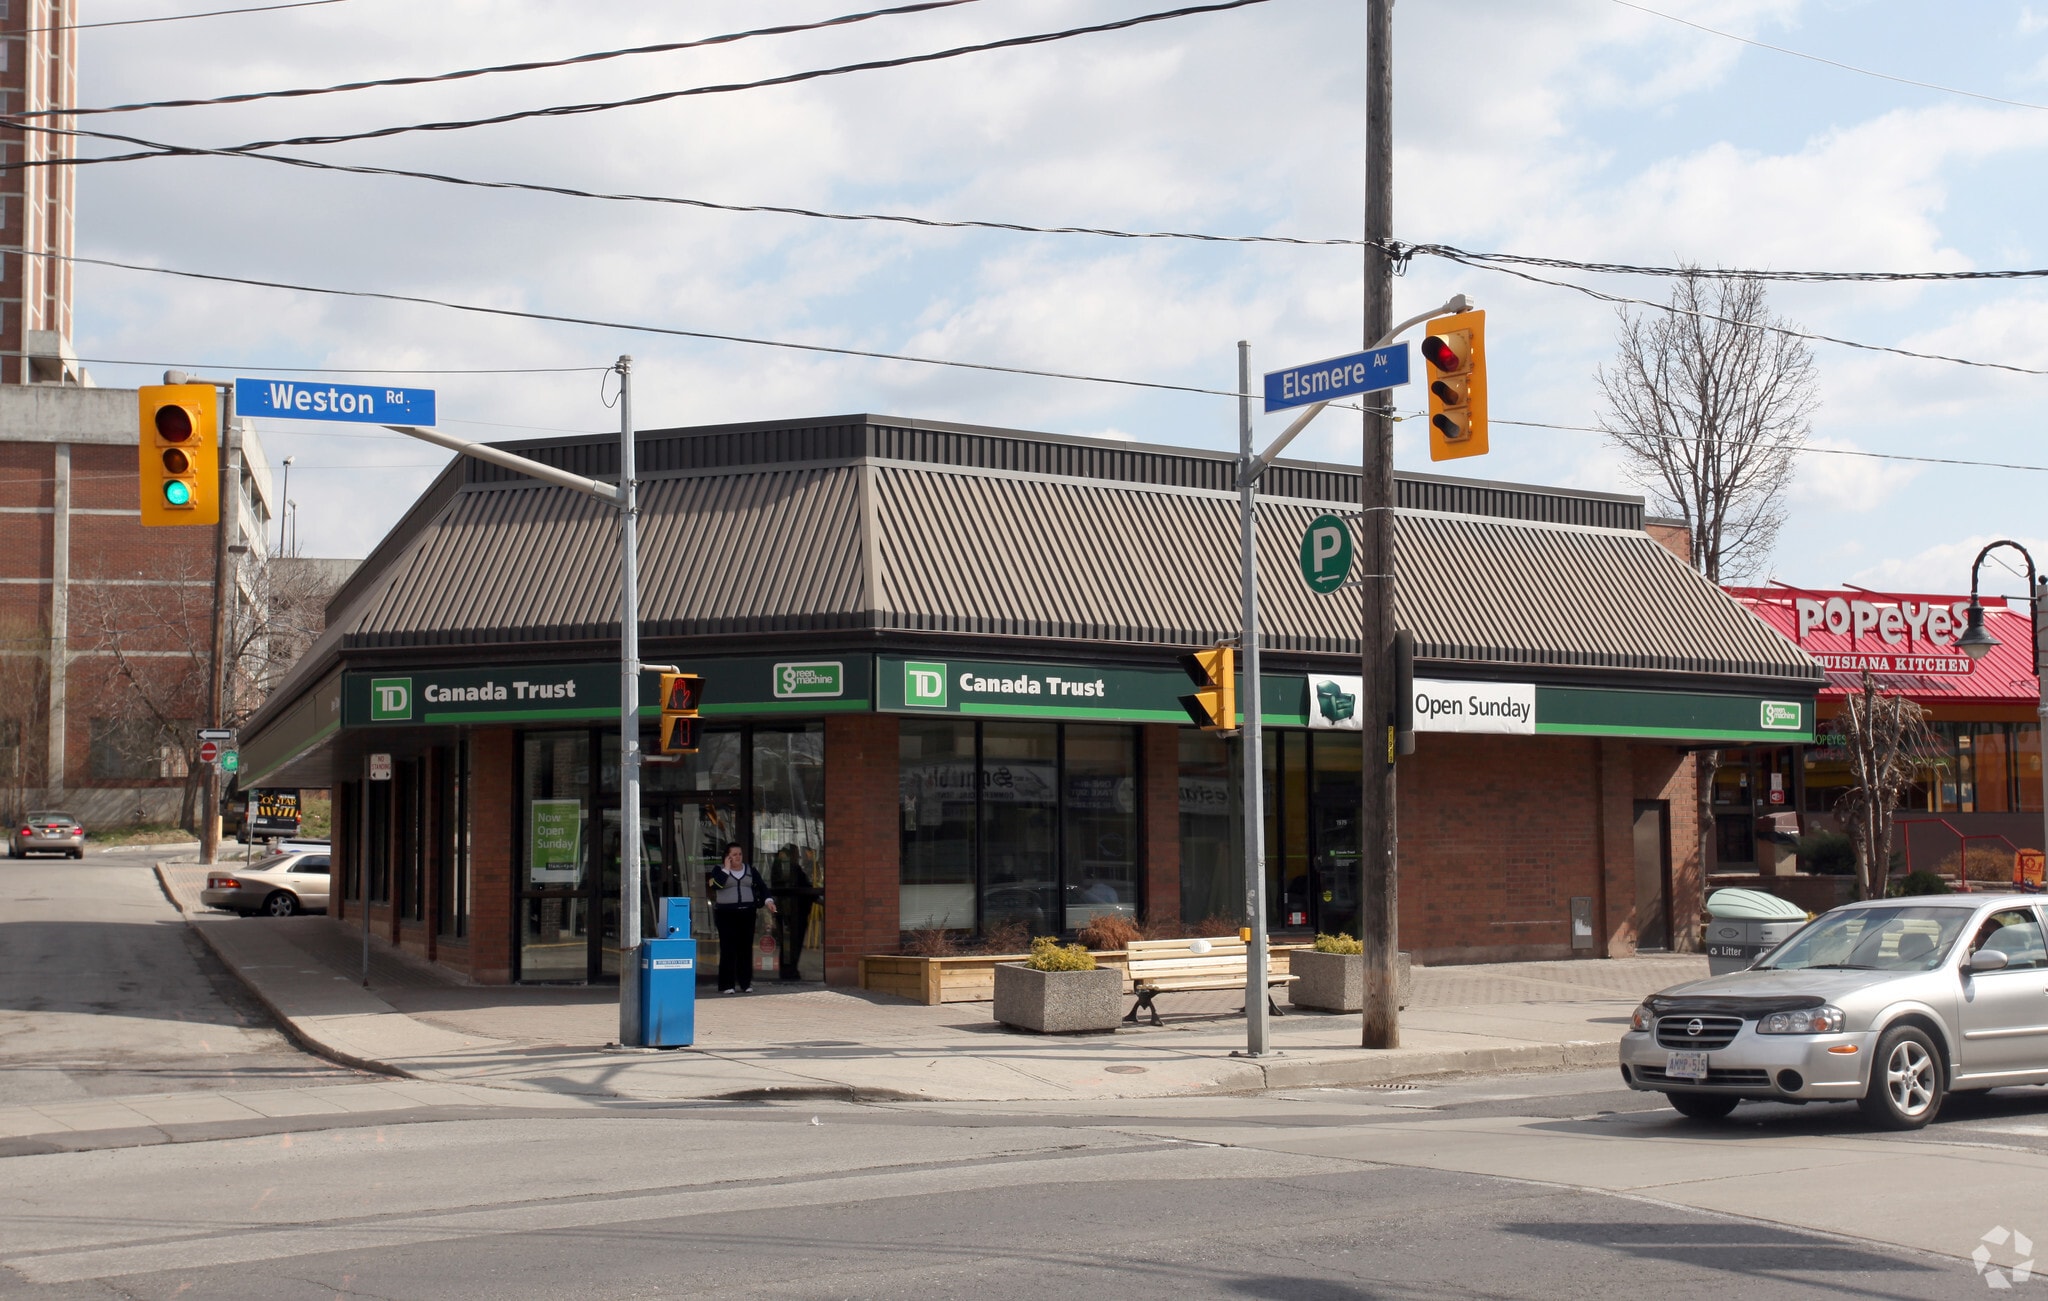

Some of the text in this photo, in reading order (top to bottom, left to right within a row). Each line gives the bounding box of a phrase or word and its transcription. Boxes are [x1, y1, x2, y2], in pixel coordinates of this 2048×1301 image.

[1283, 353, 1387, 399] Elsmere Av
[270, 383, 404, 414] Weston Rd
[1313, 526, 1342, 573] P
[1814, 655, 1970, 673] OUISIANA KITCHEN
[375, 679, 576, 712] TD Canada Trust
[909, 670, 1105, 698] TD Canada Trust
[1415, 693, 1531, 723] Open Sunday
[1816, 734, 1847, 746] OPEYES
[537, 812, 561, 823] Now
[537, 825, 564, 838] Open
[537, 838, 574, 851] Sunday
[1722, 946, 1742, 957] Litter
